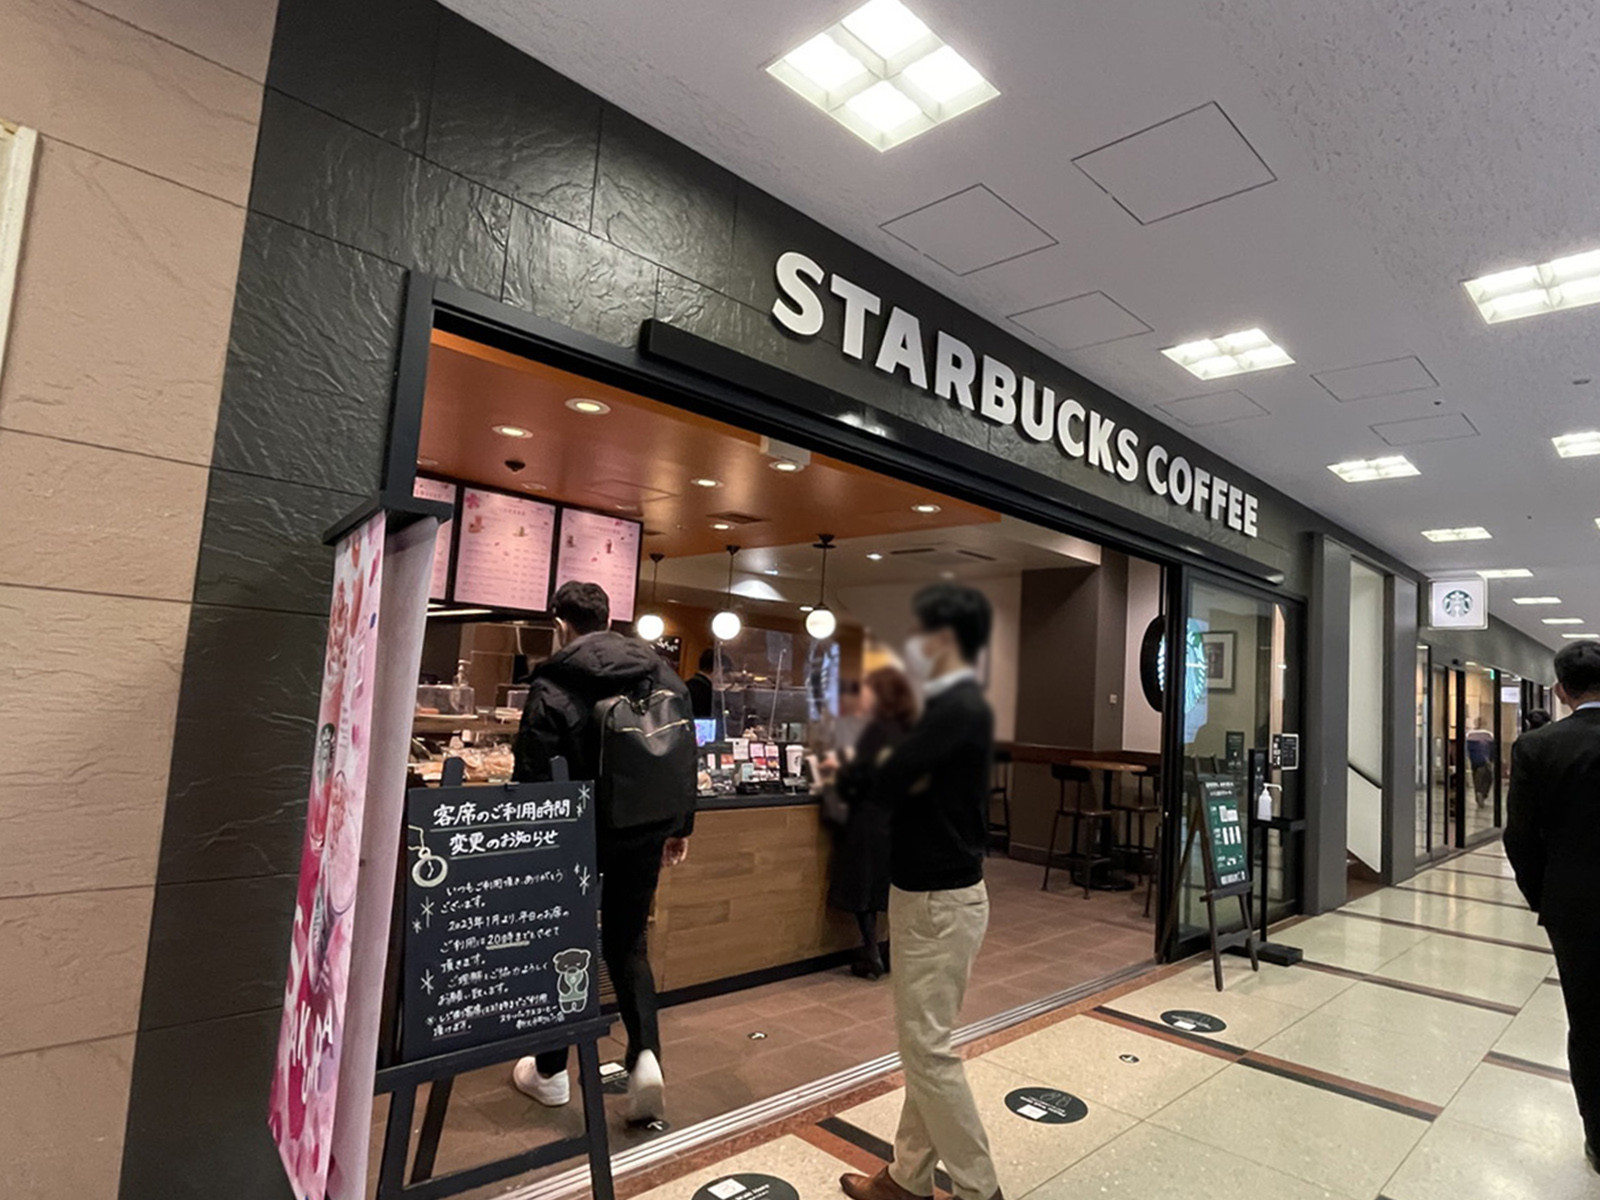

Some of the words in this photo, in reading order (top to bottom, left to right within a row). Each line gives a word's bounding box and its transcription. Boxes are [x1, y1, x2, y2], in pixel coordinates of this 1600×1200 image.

[772, 251, 1139, 482] STARBUCKS
[1146, 444, 1259, 538] COFFEE
[433, 799, 571, 826] 客席のご利用時間
[449, 830, 559, 856] 変更のお知らせ
[441, 953, 486, 973] 頂きます。
